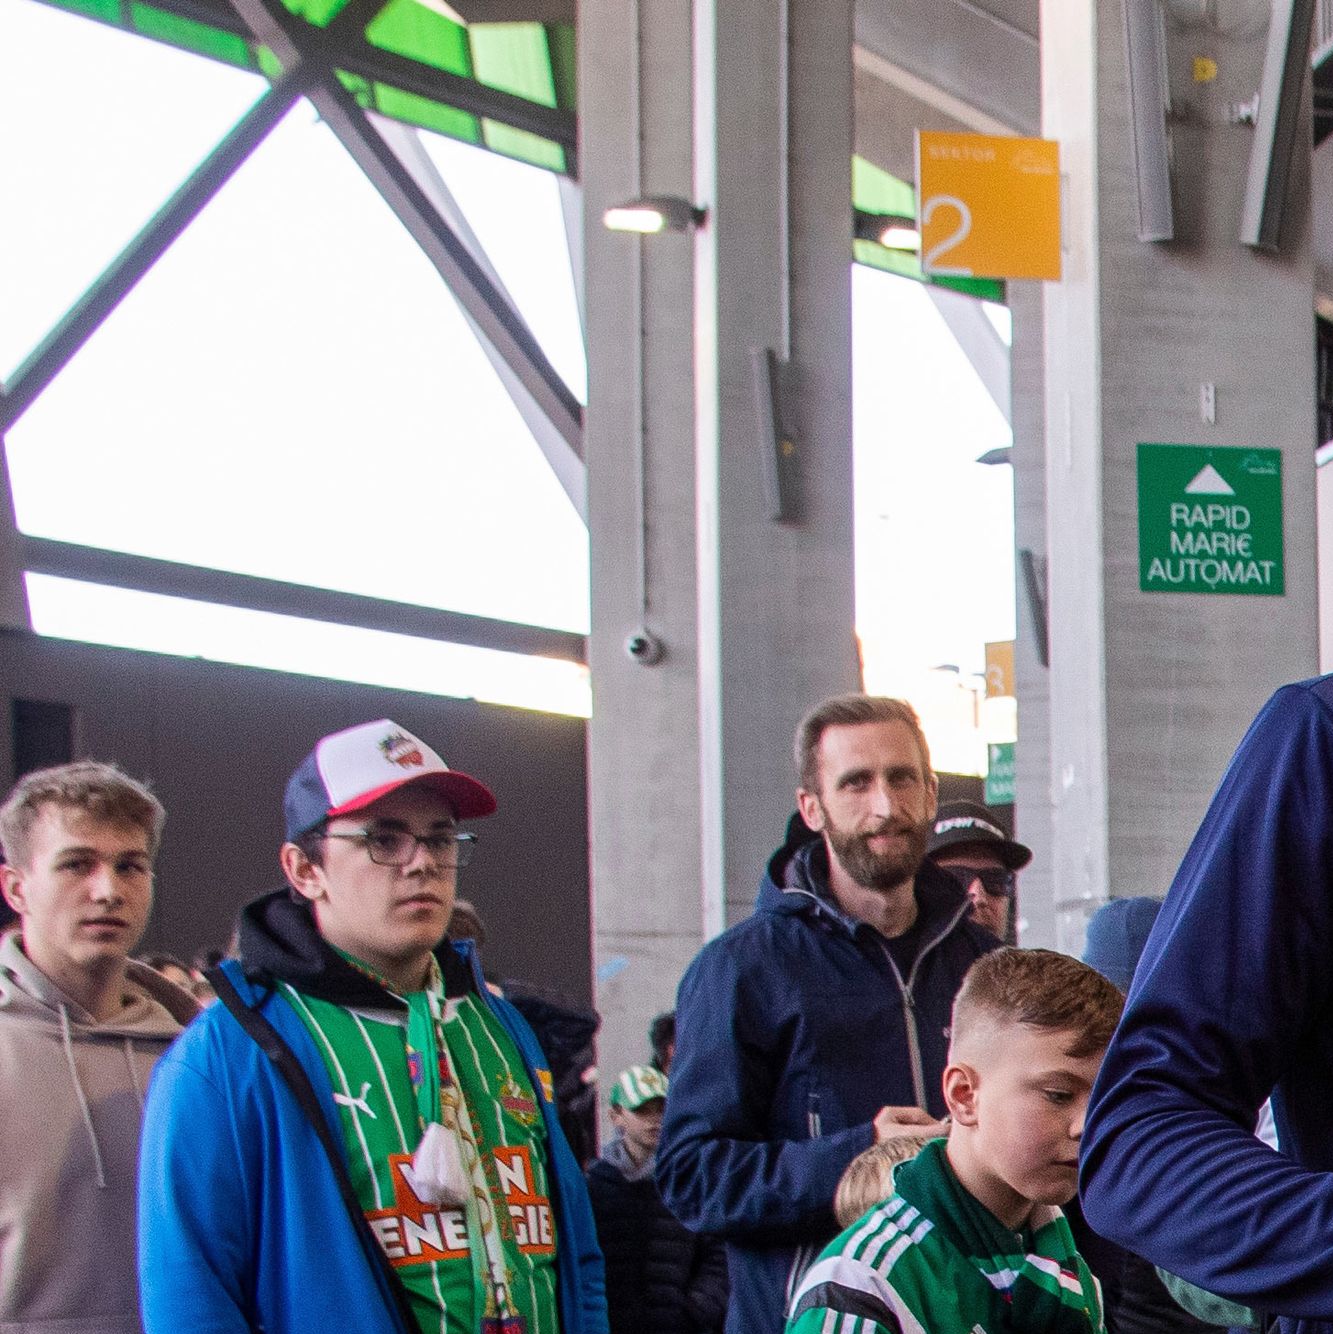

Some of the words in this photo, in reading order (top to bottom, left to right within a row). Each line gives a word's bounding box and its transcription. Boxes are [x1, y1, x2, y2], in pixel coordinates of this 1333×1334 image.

[922, 194, 973, 277] 2
[1170, 502, 1251, 530] RAPID
[1147, 557, 1277, 586] AUTOMAT
[368, 1204, 553, 1258] ENEGIE
